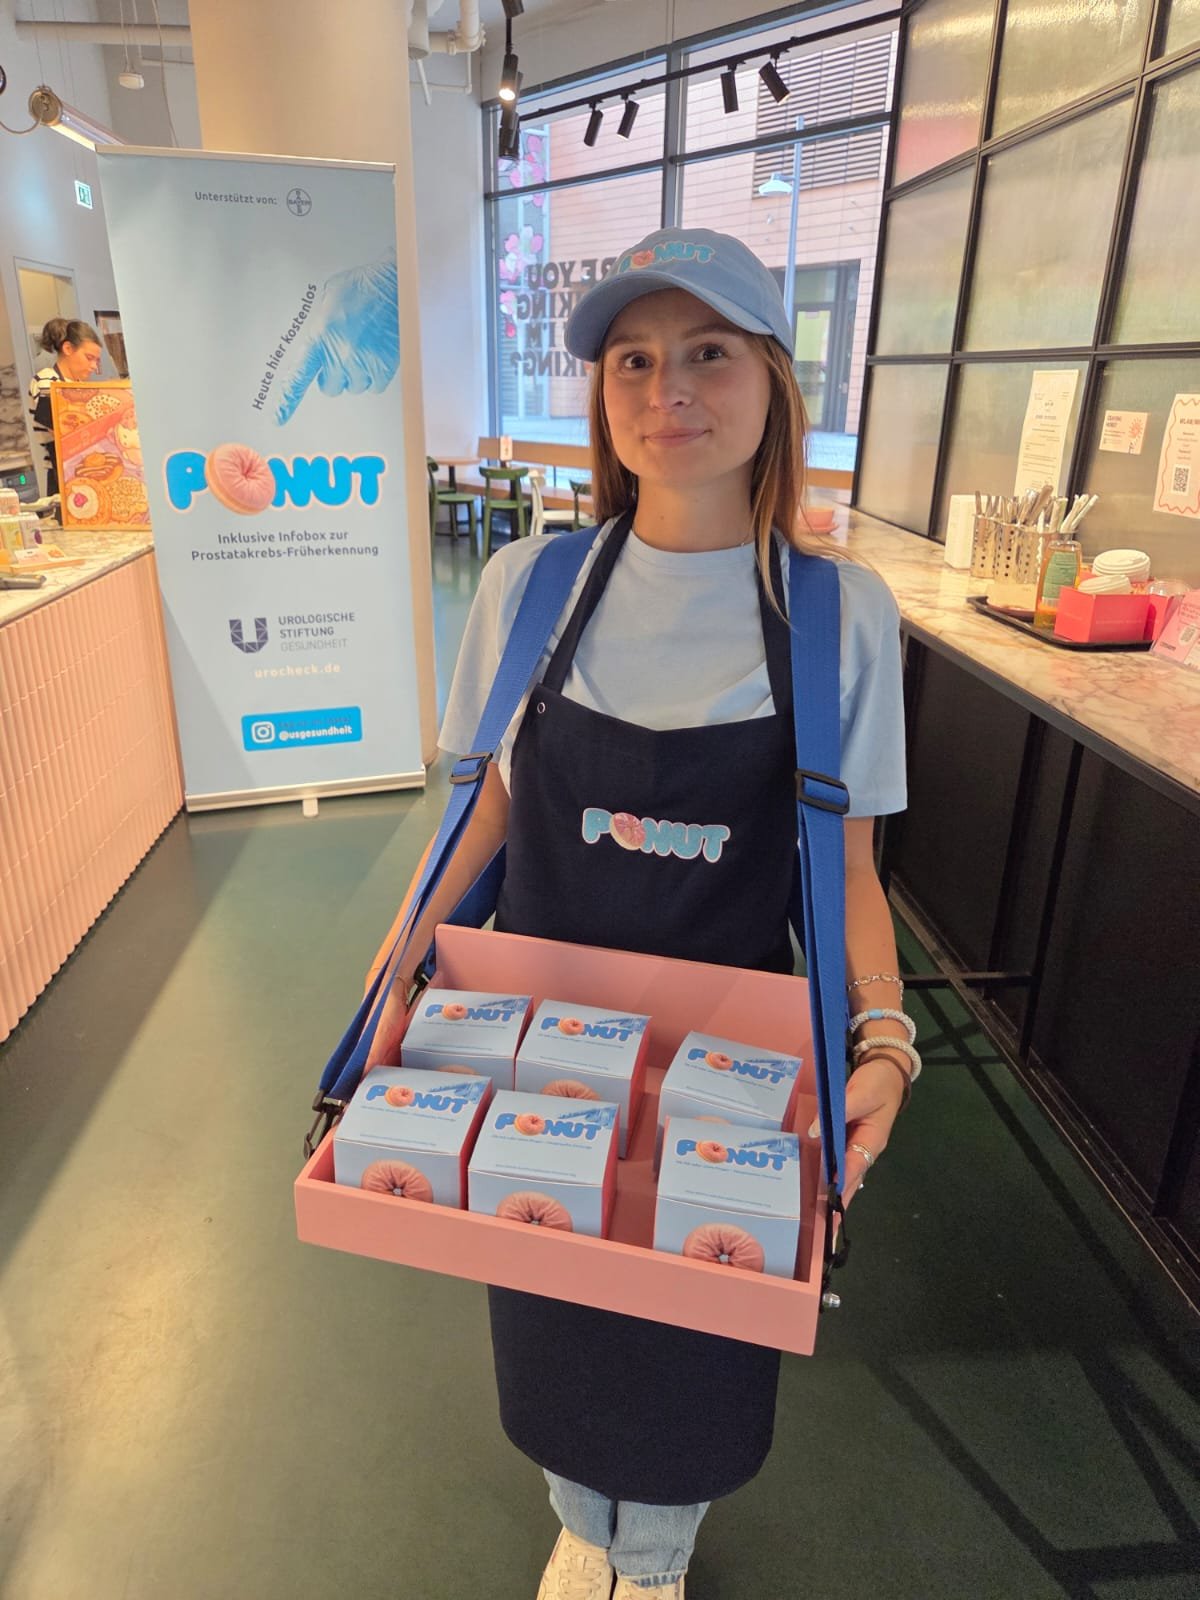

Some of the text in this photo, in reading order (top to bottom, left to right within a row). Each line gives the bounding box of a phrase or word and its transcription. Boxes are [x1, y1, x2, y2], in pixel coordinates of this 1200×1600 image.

[194, 191, 278, 205] Unterstützt von:
[252, 283, 317, 410] Heute hier kostenlos
[217, 530, 349, 544] Inklusive Infobox zur
[191, 545, 379, 561] Prostatakrebs-Früherkennung
[278, 612, 356, 625] UROLOGISCHE
[279, 626, 335, 639] STIFTUNG
[280, 638, 348, 652] GESUNDHEIT
[255, 663, 341, 679] urocheck.de
[278, 725, 353, 741] @usgesundheit
